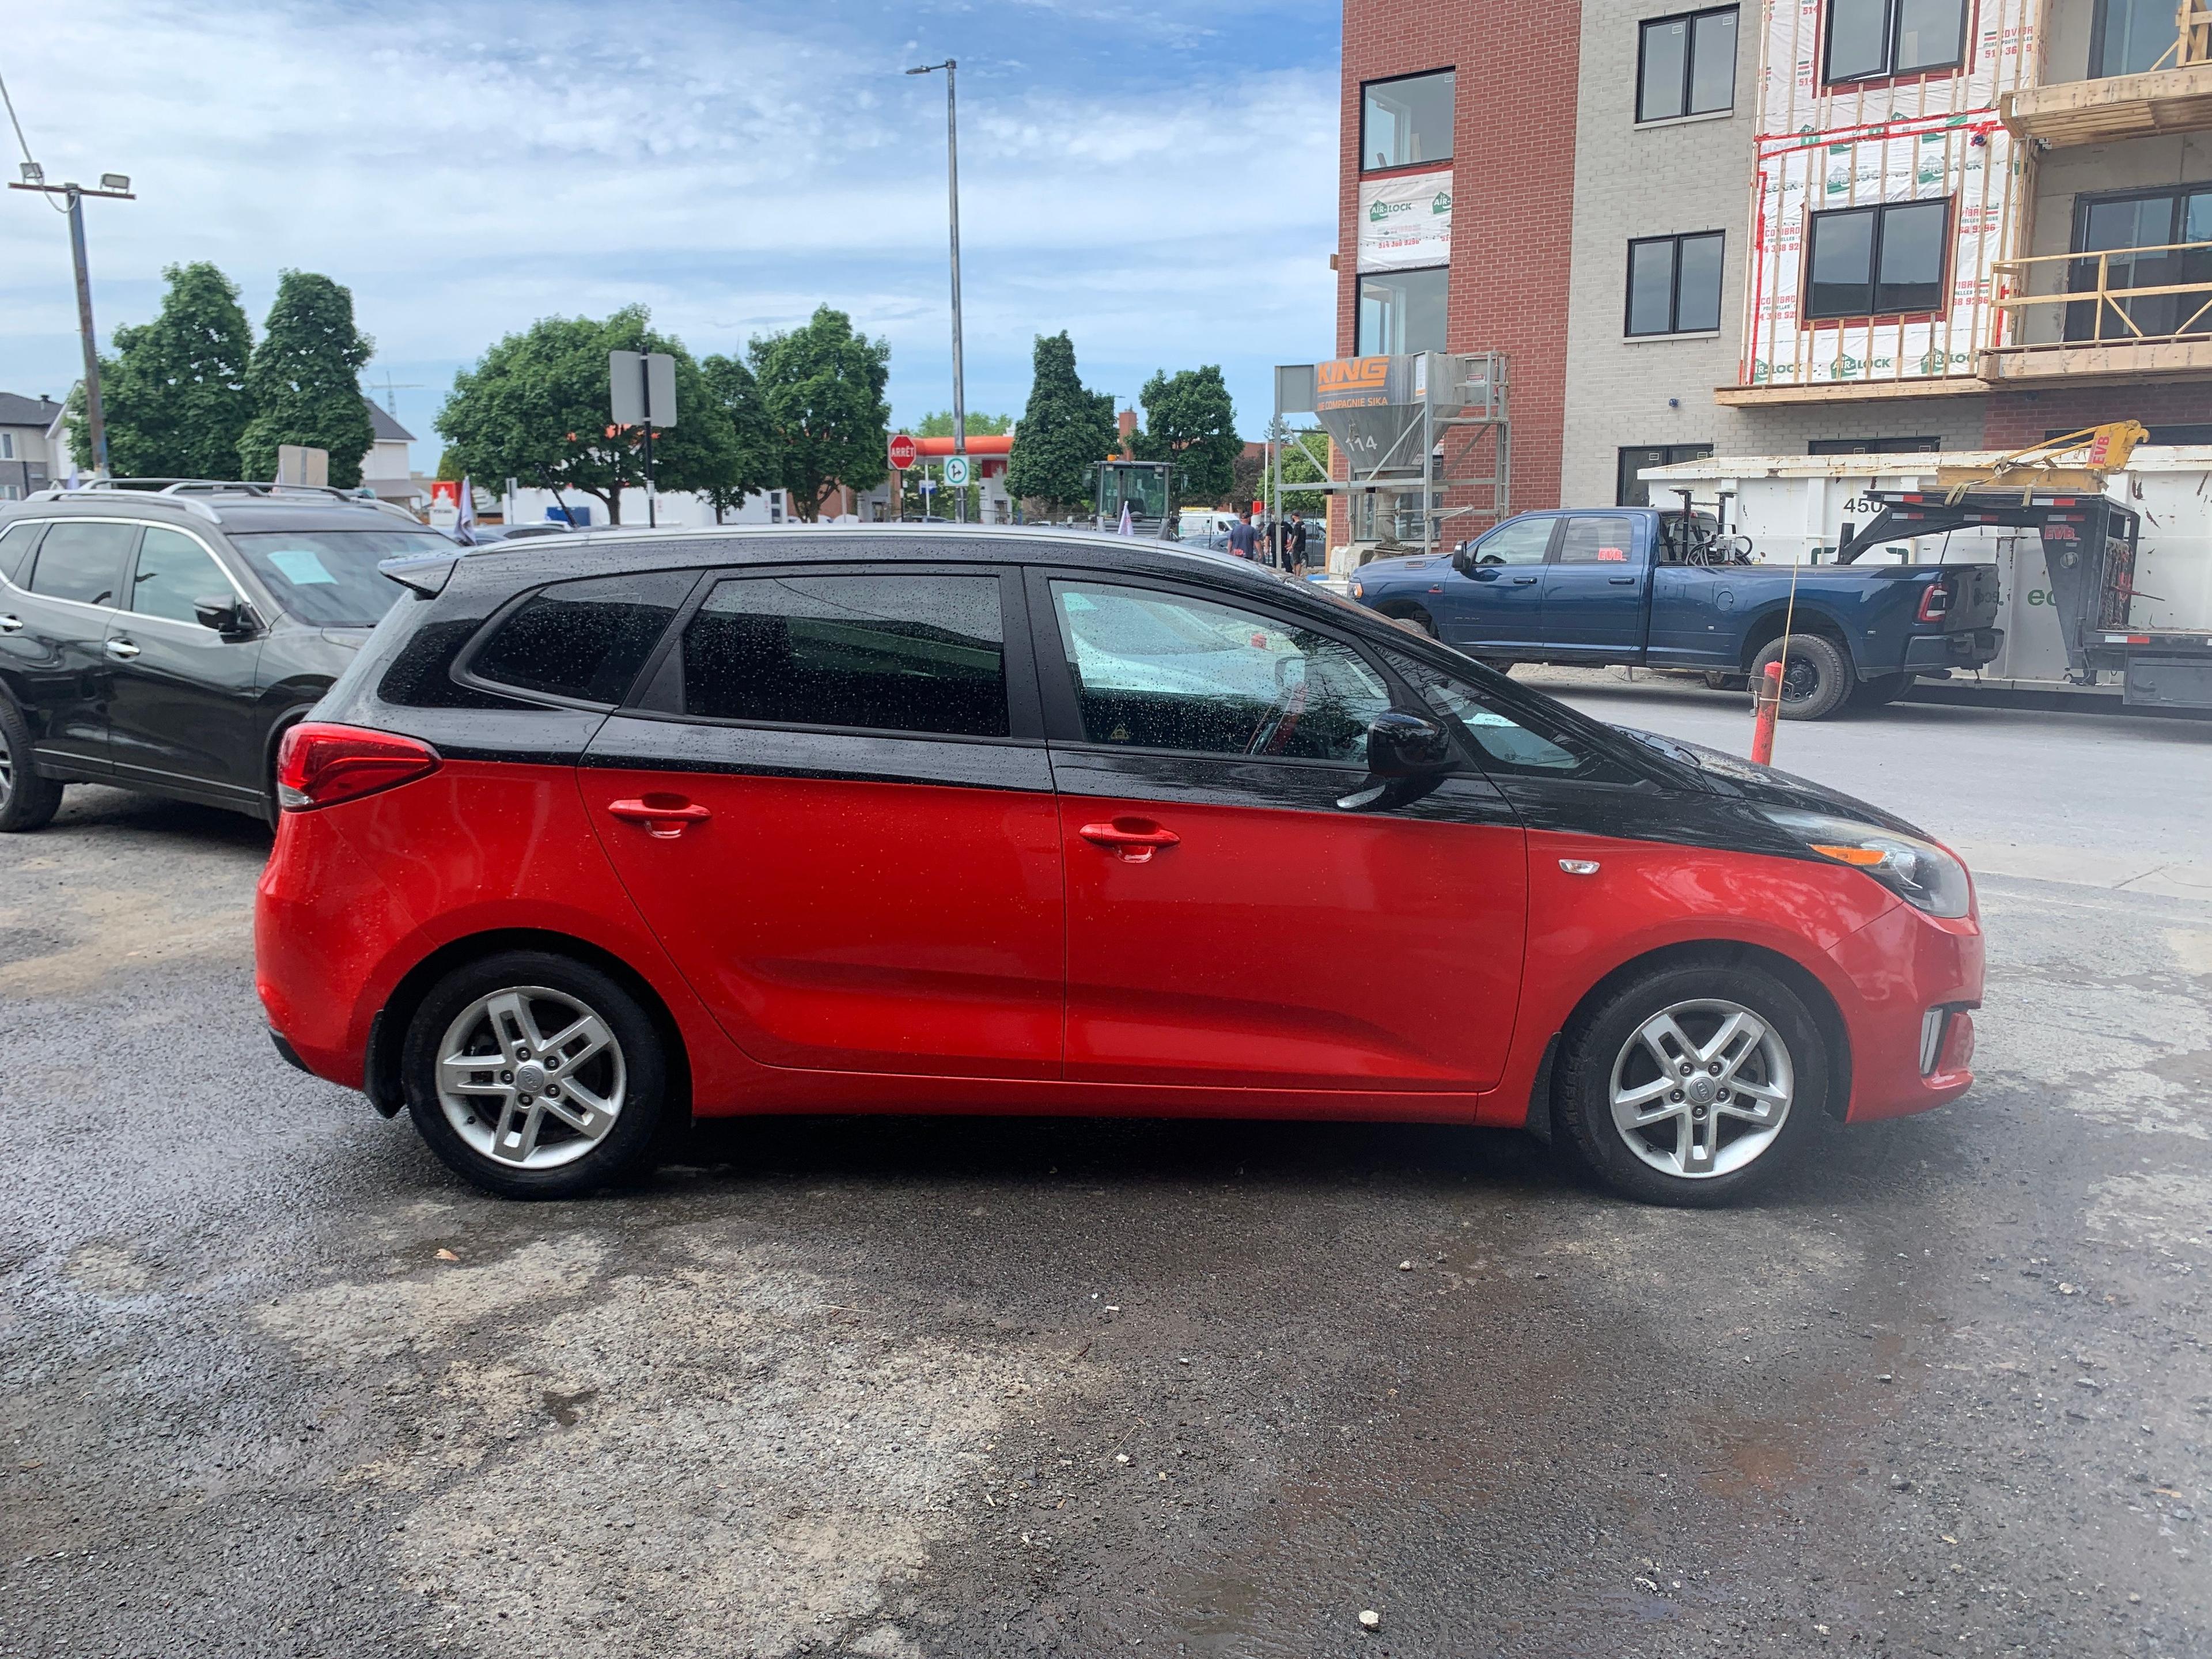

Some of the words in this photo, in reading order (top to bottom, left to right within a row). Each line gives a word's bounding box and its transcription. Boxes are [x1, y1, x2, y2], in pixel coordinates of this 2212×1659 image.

[1765, 226, 1800, 237] COIBRO
[1760, 295, 1796, 305] COIBRO
[1318, 356, 1389, 385] KING
[1325, 397, 1366, 410] COMPAGNIE
[1368, 396, 1388, 406] SIKA
[891, 446, 915, 457] ARRÊT
[2092, 436, 2110, 464] EVB
[2044, 527, 2075, 540] EVB
[1598, 550, 1623, 560] EVB
